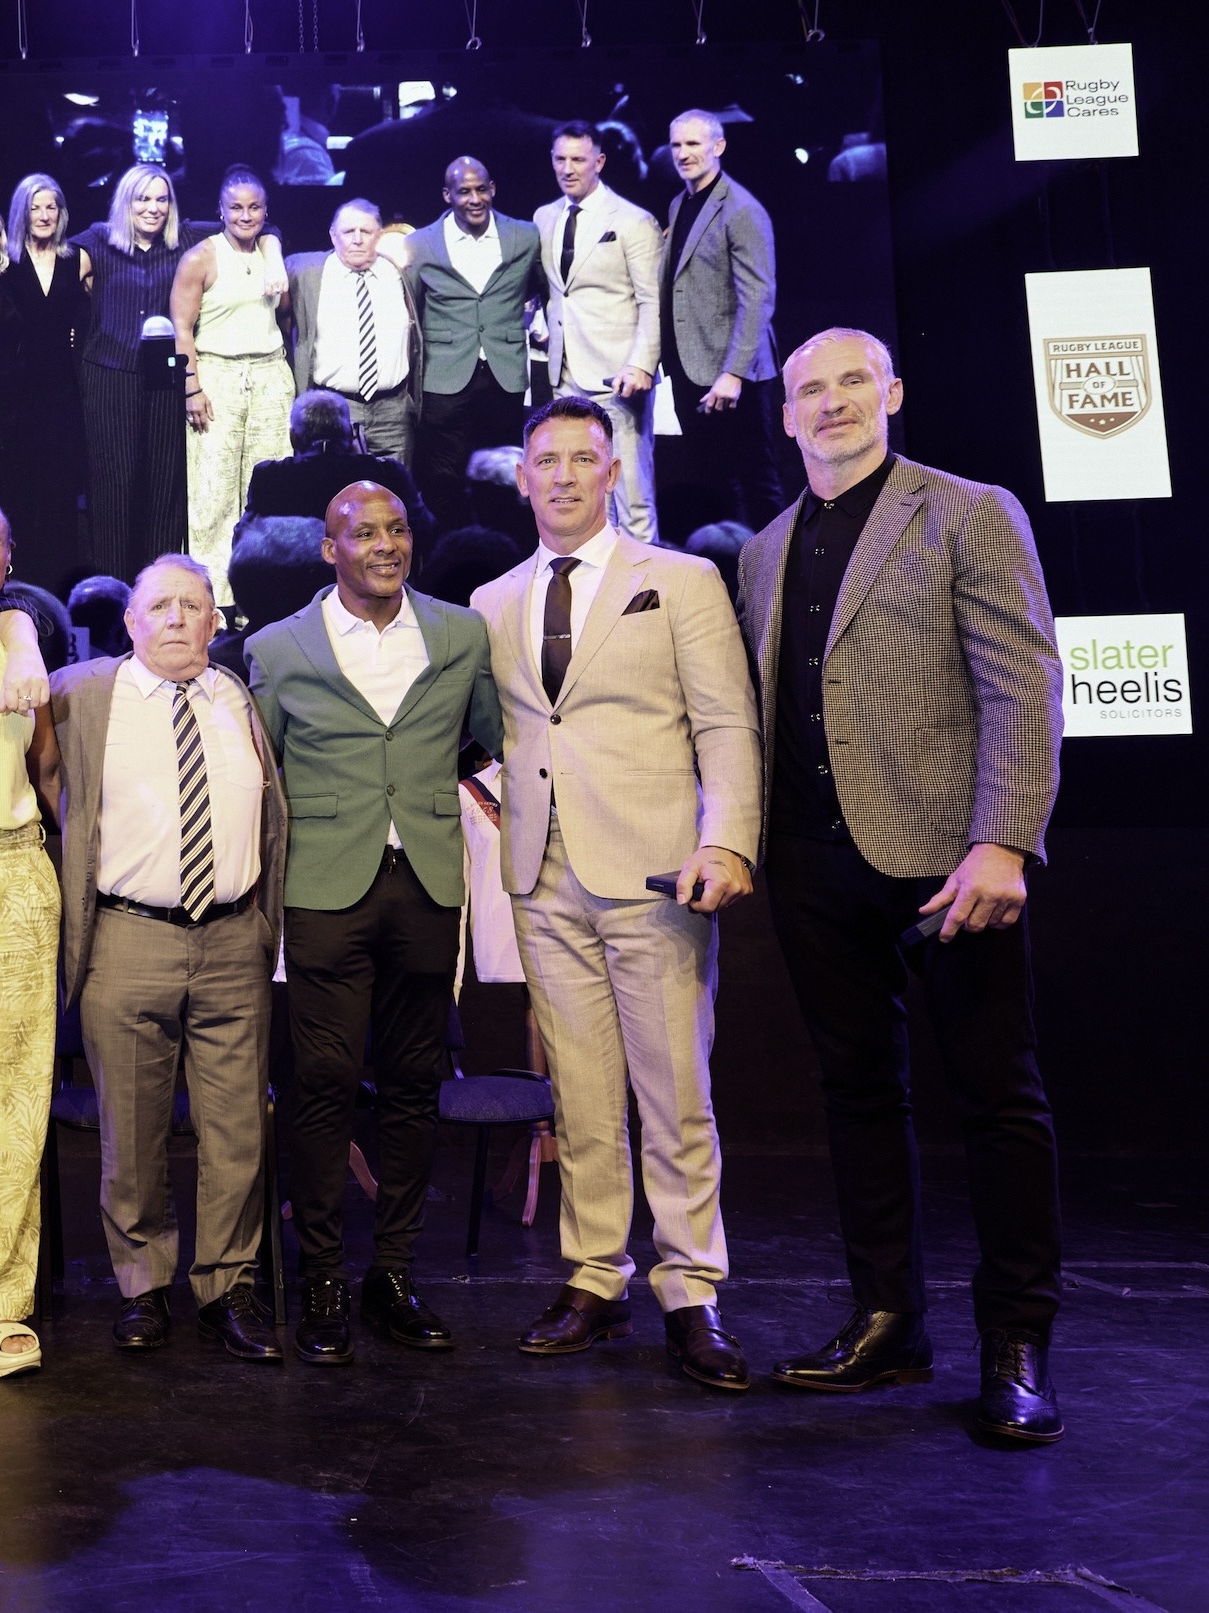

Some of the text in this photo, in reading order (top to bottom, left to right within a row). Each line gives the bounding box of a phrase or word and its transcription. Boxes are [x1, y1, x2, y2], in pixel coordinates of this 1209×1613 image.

[1065, 79, 1120, 93] Rugby
[1066, 94, 1129, 106] League
[1067, 107, 1119, 118] Cares
[1053, 341, 1139, 352] RUGBY LEAGUE
[1065, 361, 1130, 378] HALL
[1092, 381, 1106, 389] OF
[1068, 392, 1134, 409] FAME
[1070, 639, 1174, 671] slater
[1071, 671, 1183, 705] heelis
[1100, 708, 1182, 719] SOLICITORS
